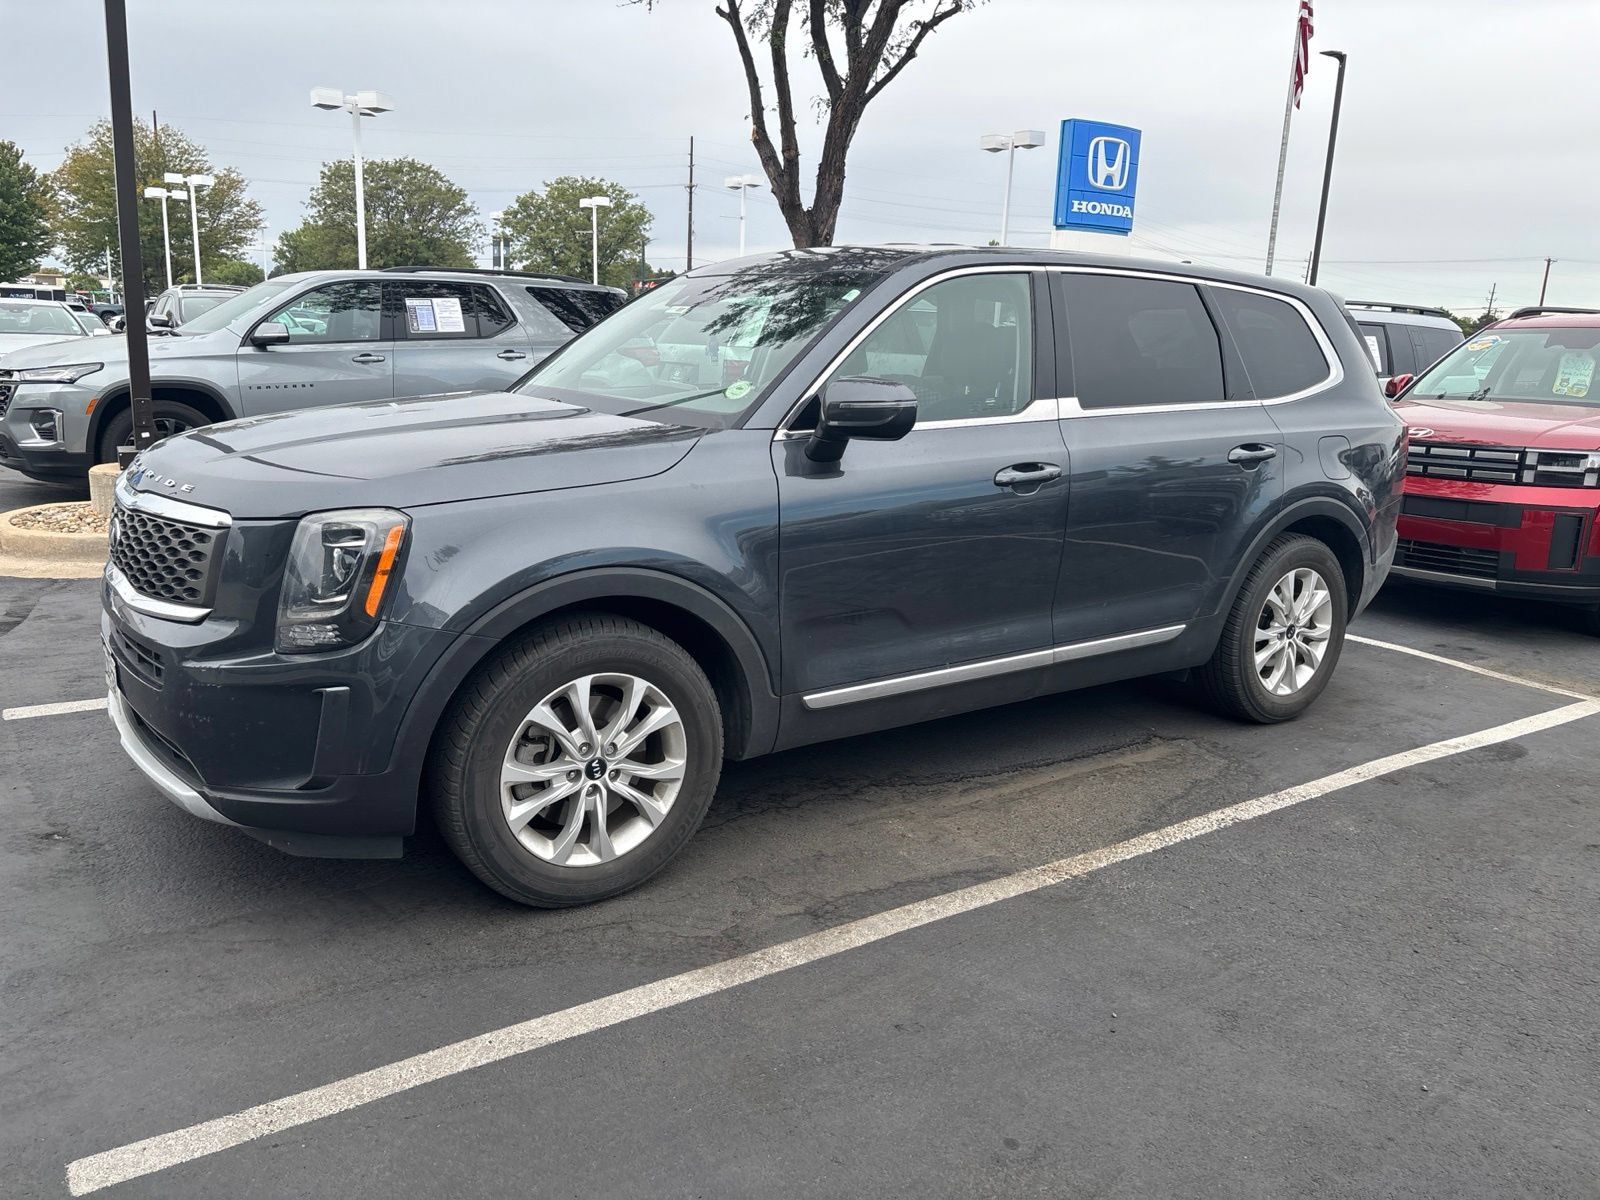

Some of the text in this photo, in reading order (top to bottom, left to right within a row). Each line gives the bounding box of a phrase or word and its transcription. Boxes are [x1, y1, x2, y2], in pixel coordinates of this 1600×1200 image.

[1071, 200, 1132, 218] HONDA
[247, 383, 315, 391] TRAVERSE
[591, 759, 602, 779] KIA
